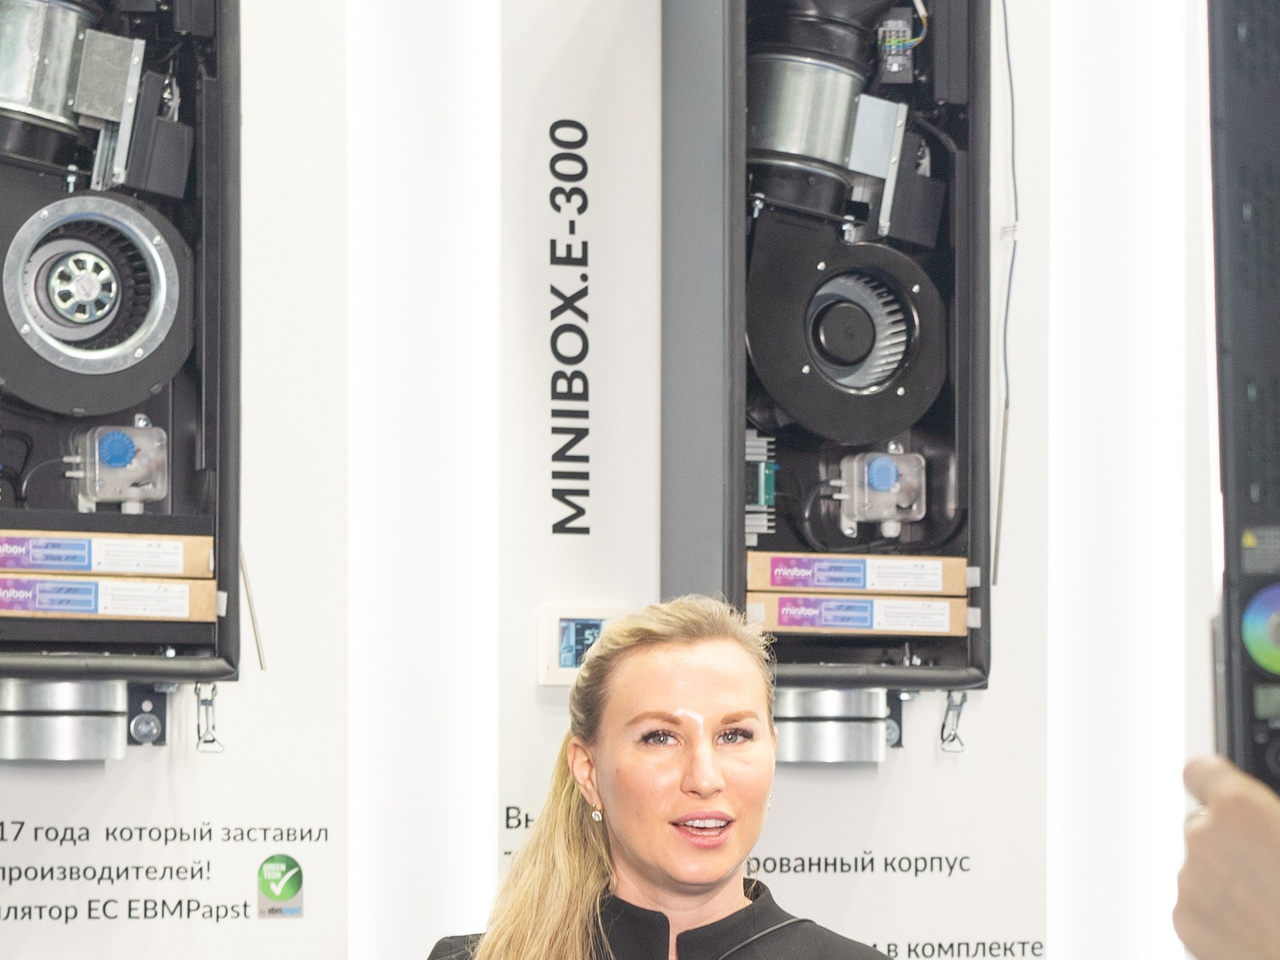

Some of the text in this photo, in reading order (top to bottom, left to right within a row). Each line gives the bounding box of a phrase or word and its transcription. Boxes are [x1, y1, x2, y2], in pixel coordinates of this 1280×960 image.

[548, 118, 591, 537] MINIBOX.E-300
[774, 566, 813, 578] minibox
[781, 605, 820, 616] minibox
[0, 820, 329, 847] 17 года который заставил
[746, 850, 971, 878] рованный корпус
[0, 904, 78, 924] лятор
[127, 899, 250, 923] EBMPapst
[887, 940, 1044, 959] в комплекте
